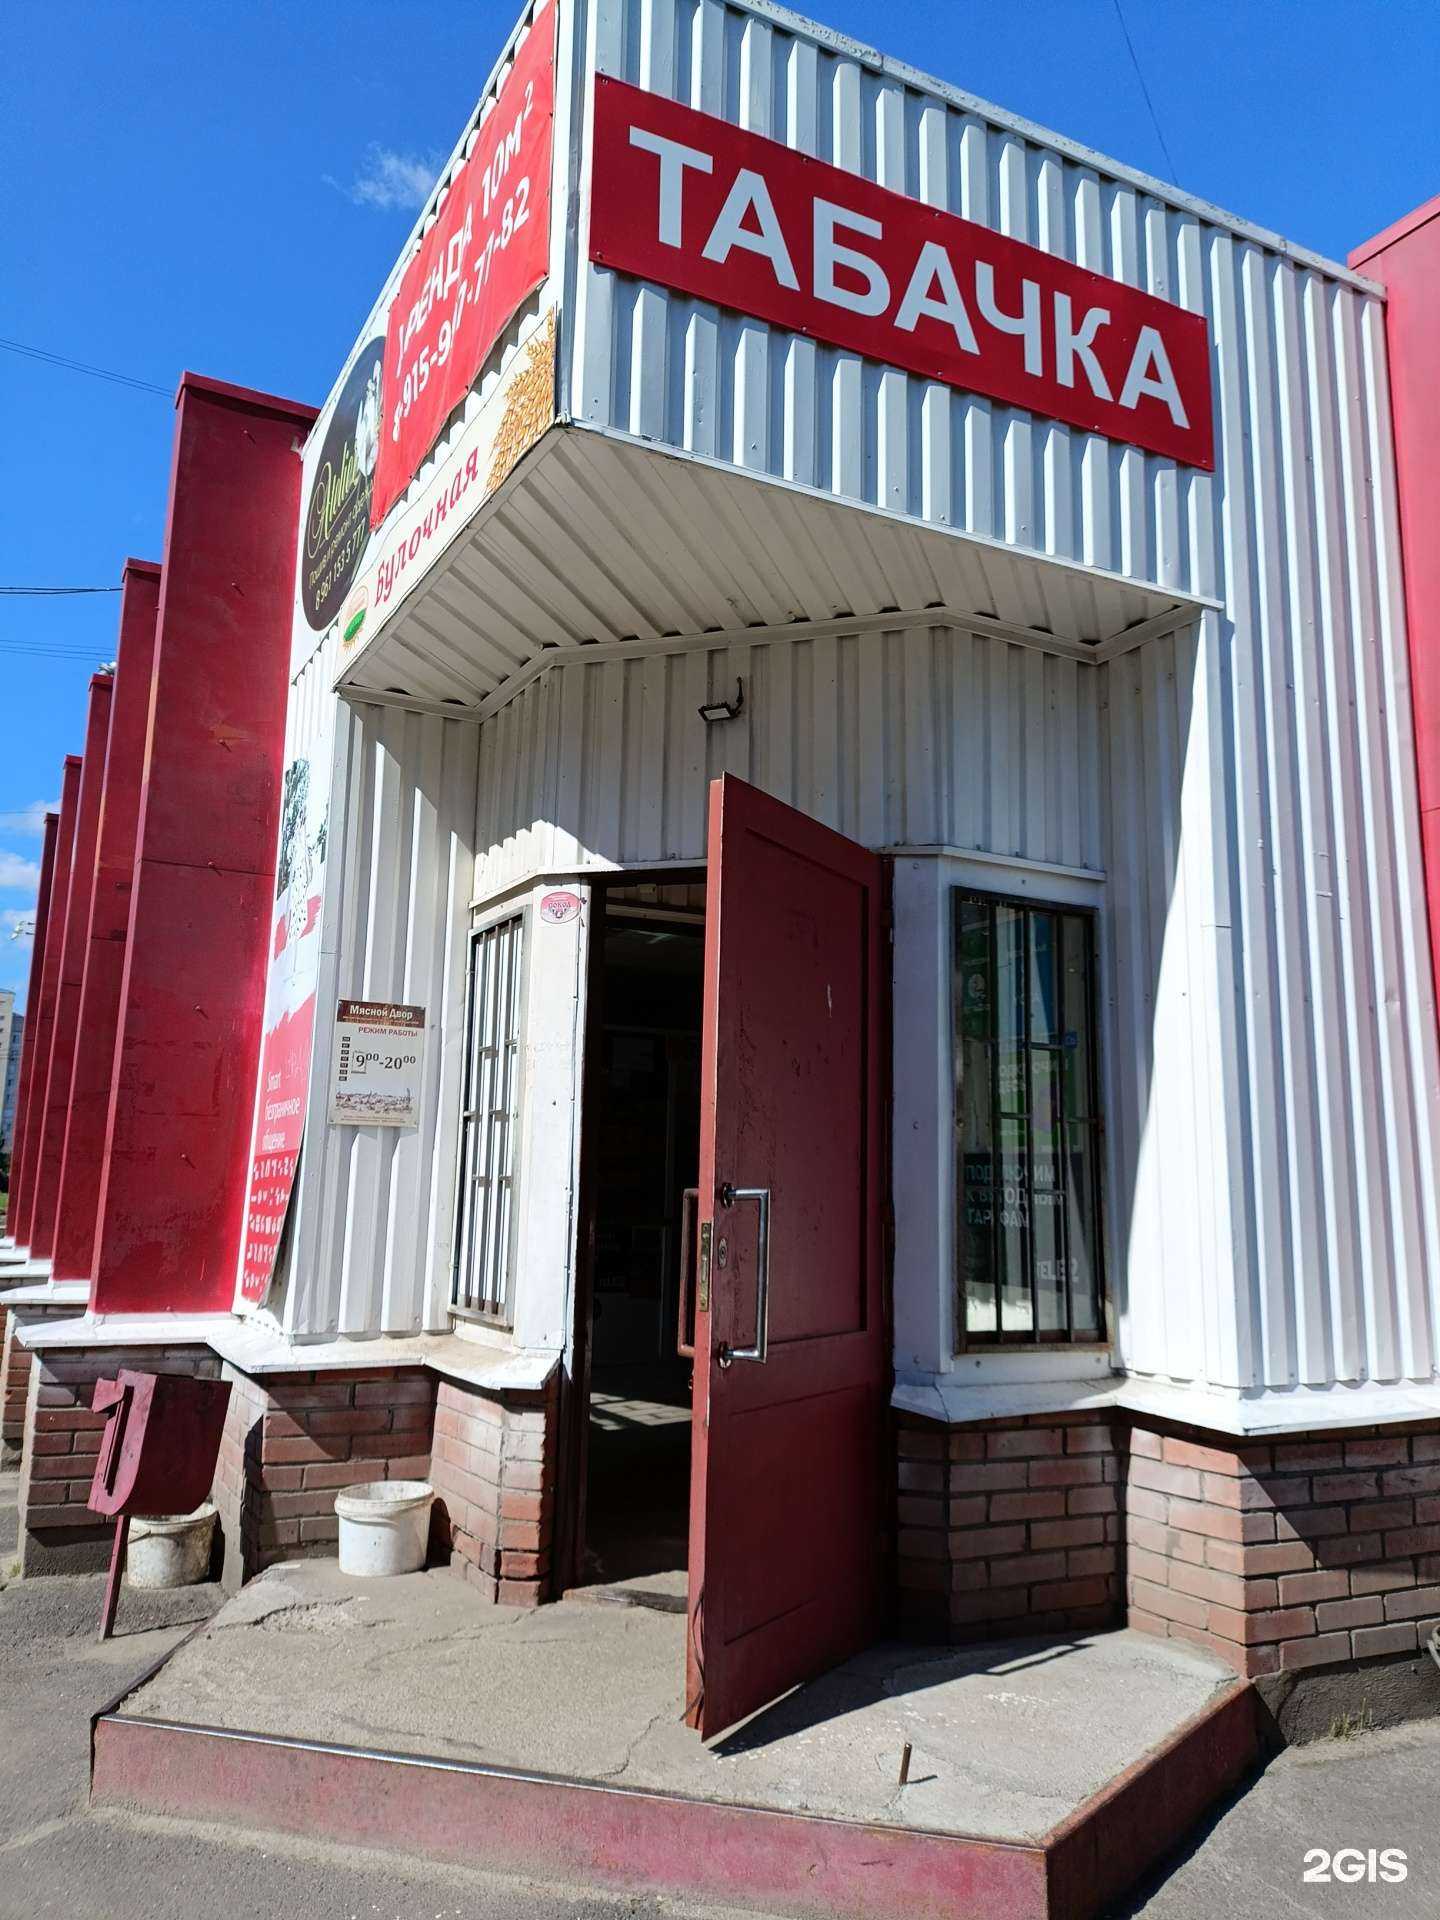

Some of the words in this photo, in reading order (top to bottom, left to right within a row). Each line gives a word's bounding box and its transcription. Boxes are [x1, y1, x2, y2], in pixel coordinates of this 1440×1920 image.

[628, 125, 1191, 430] ТАБАЧКА
[350, 1005, 388, 1017] Мясной
[389, 1009, 413, 1020] Двор
[358, 1026, 387, 1036] РЕЖИМ
[388, 1028, 418, 1037] РАБОТЫ
